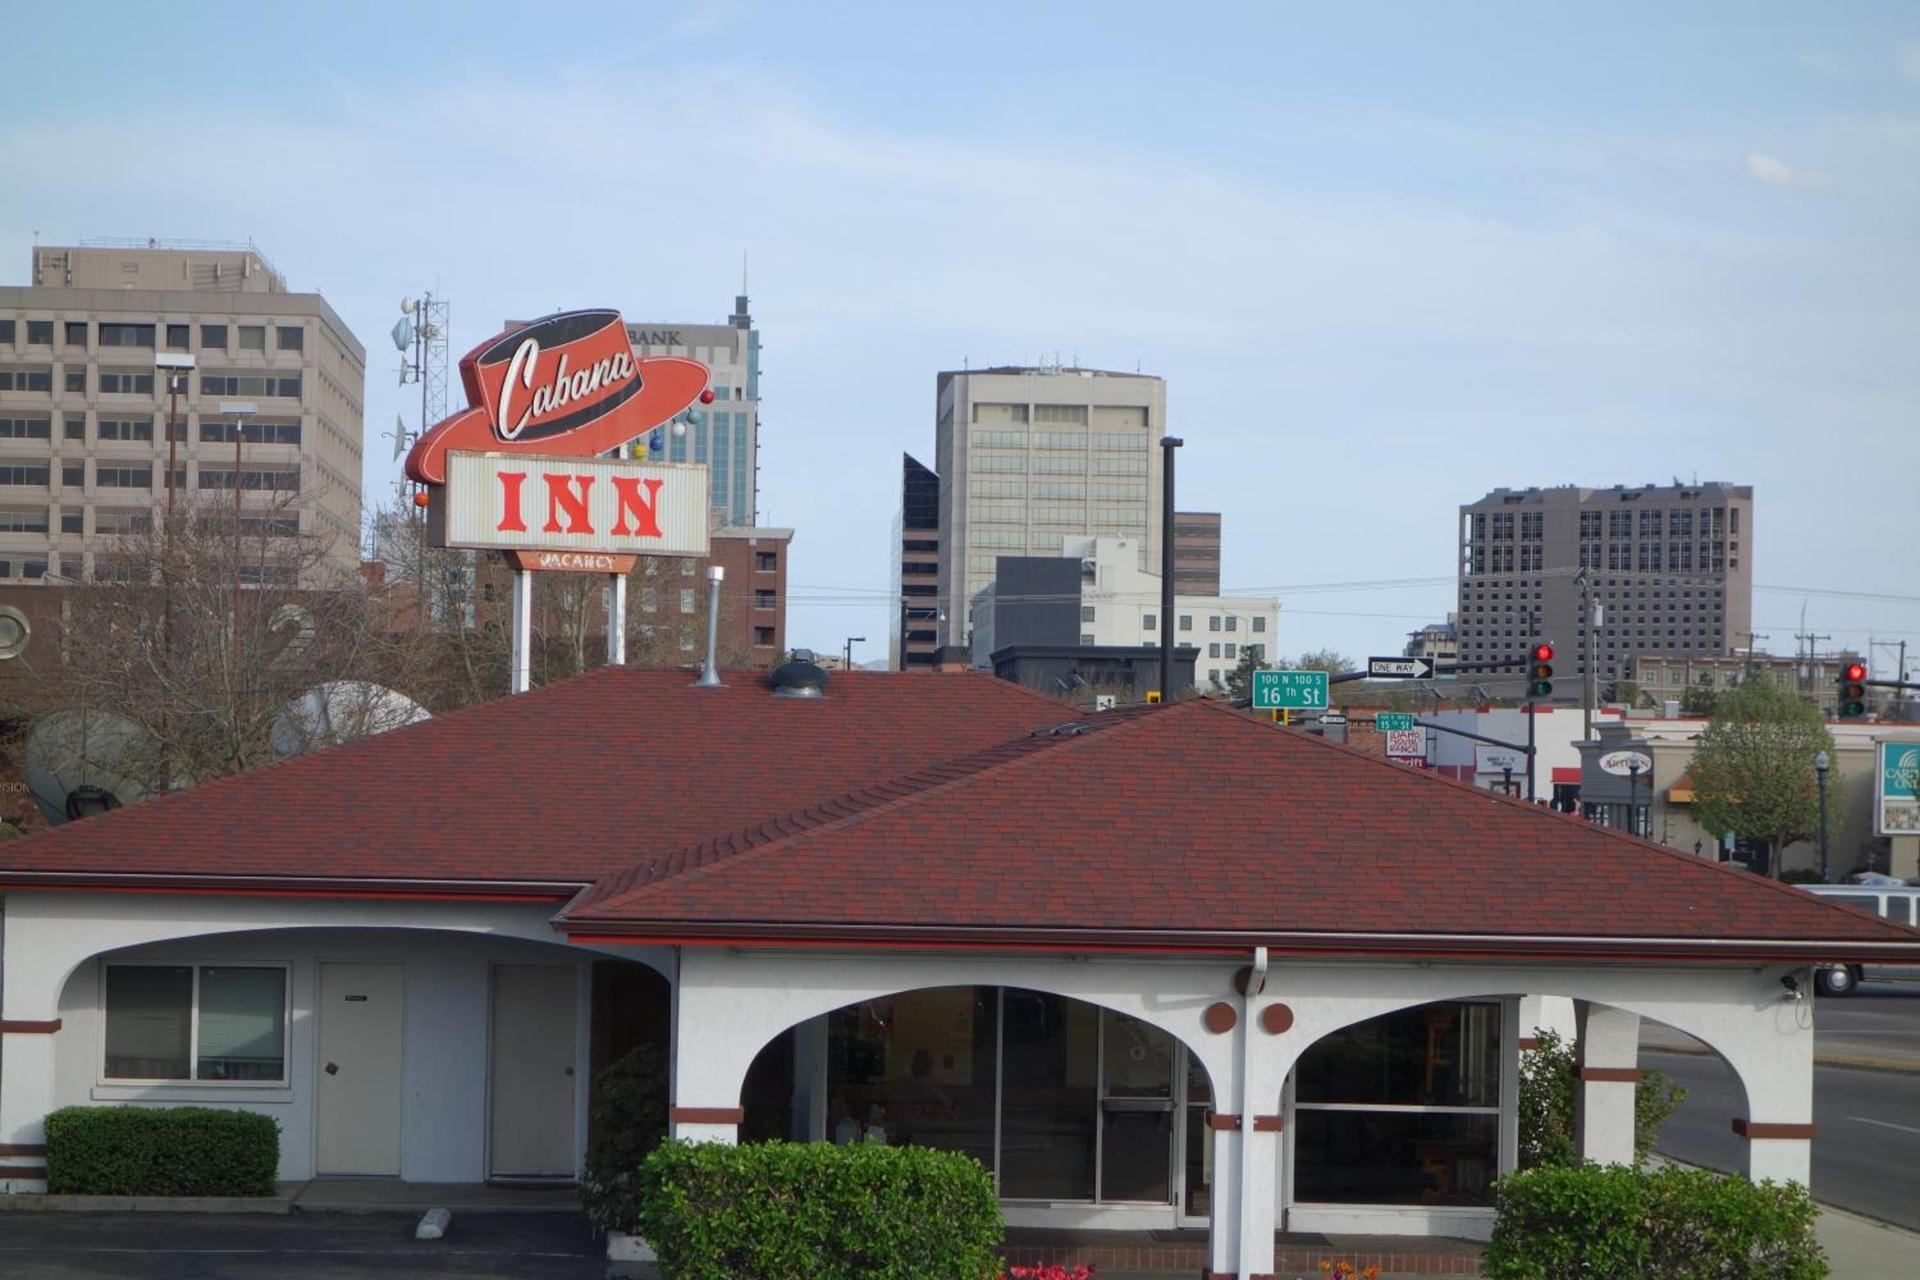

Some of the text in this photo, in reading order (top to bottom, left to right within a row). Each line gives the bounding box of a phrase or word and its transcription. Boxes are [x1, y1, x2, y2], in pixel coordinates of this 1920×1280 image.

[627, 329, 683, 346] BANK
[499, 337, 636, 440] Cabana
[496, 471, 664, 538] INN
[540, 553, 614, 570] VACANCY
[1374, 662, 1415, 673] ONE WAY
[1261, 674, 1321, 685] 100 N 100 S
[1262, 687, 1281, 705] 16
[1302, 687, 1320, 705] St
[1380, 720, 1390, 729] 15
